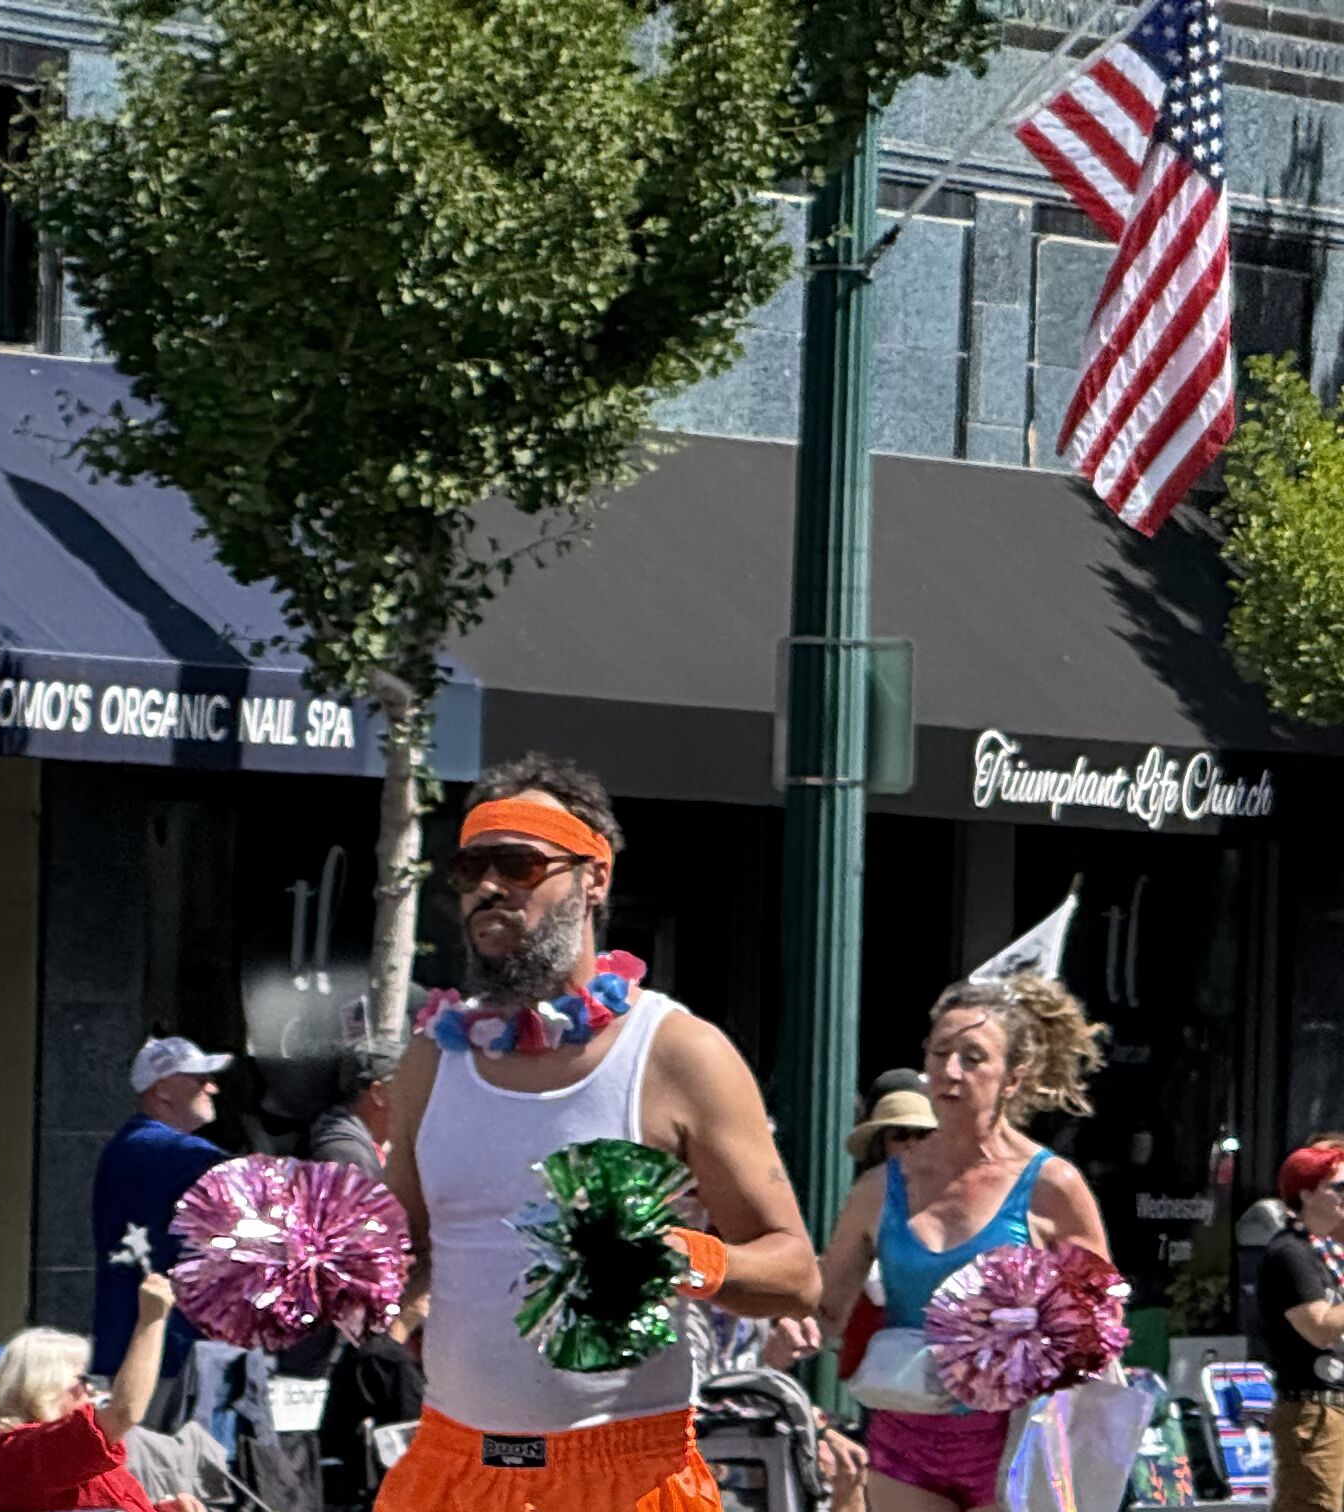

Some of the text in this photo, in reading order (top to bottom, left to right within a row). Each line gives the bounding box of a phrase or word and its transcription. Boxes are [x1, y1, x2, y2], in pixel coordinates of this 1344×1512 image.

[100, 685, 230, 742] ORGANIC
[238, 697, 298, 746] NAIL
[305, 699, 355, 749] SPA
[973, 729, 1274, 831] Triumphant Life Church
[1134, 1190, 1216, 1227] Wednesday
[1157, 1232, 1169, 1263] 7
